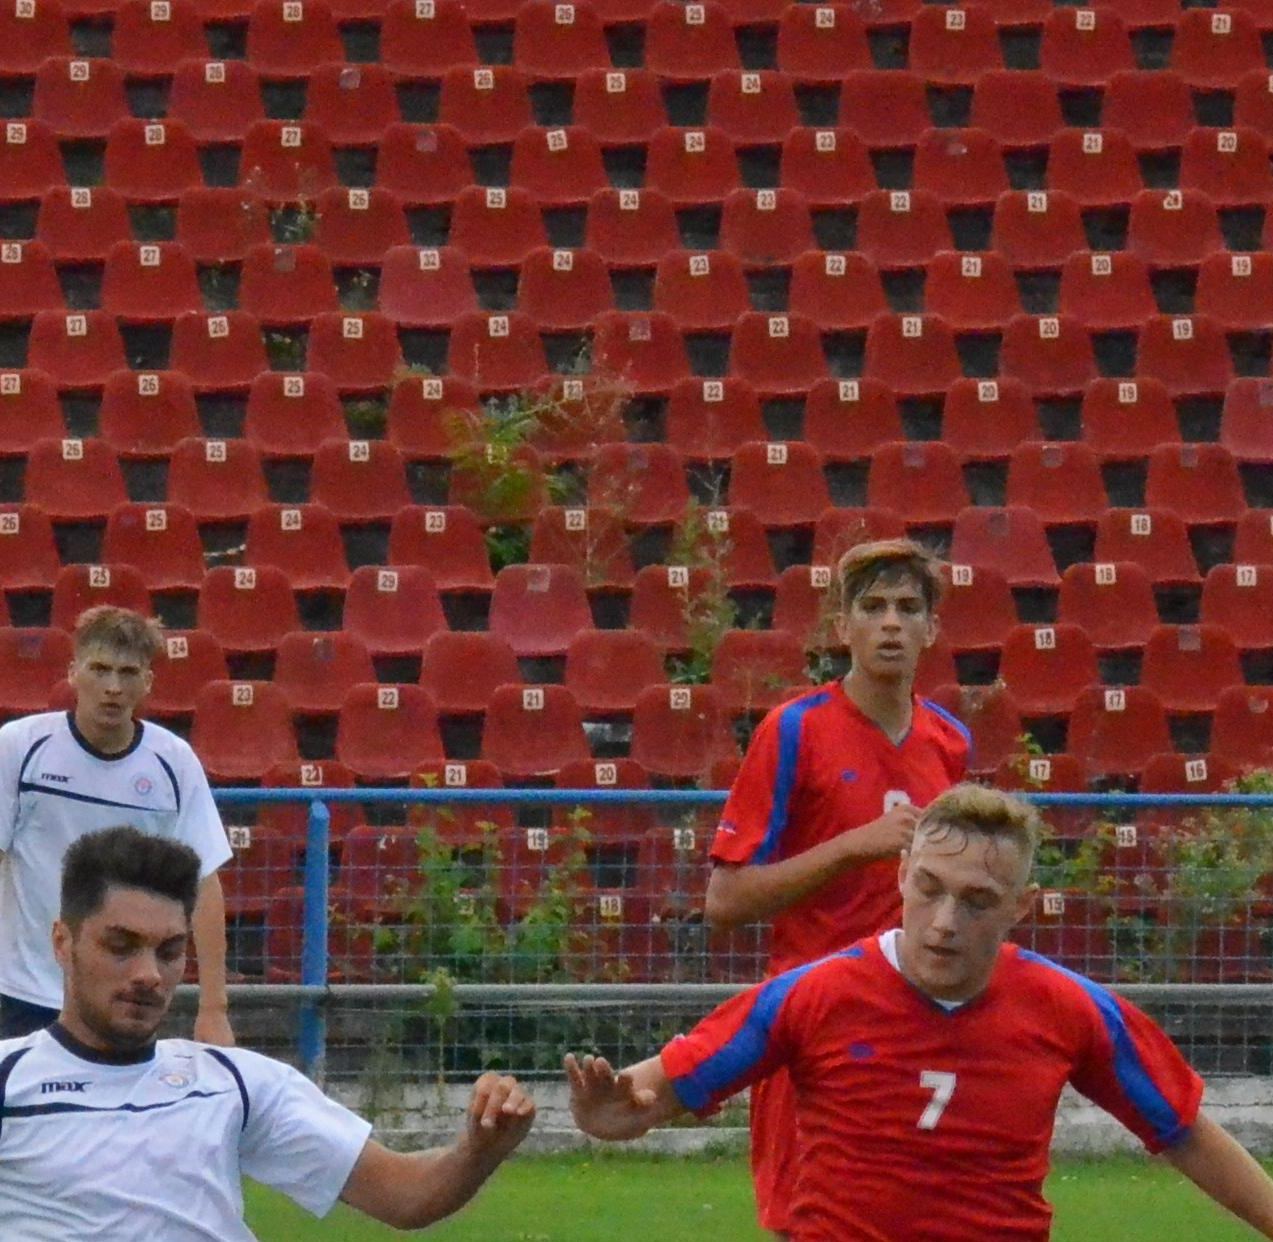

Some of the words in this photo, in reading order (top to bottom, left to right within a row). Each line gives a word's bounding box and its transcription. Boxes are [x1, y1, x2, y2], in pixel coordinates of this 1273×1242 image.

[74, 191, 89, 205] 28
[351, 193, 367, 207] 26
[488, 191, 504, 207] 25
[623, 194, 637, 207] 24
[894, 194, 907, 210] 22
[1030, 195, 1044, 210] 21
[693, 258, 708, 273] 23
[829, 259, 843, 274] 22
[964, 259, 978, 275] 21
[69, 318, 83, 333] 27
[211, 320, 227, 335] 26
[346, 321, 360, 336] 25
[493, 319, 507, 334] 24
[772, 320, 785, 335] 22
[1042, 321, 1057, 336] 20
[1176, 322, 1190, 337] 19
[3, 376, 17, 391] 27
[141, 377, 157, 393] 26
[426, 382, 441, 397] 24
[707, 384, 721, 399] 22
[842, 384, 856, 399] 21
[65, 442, 81, 457] 26
[352, 444, 368, 459] 24
[769, 446, 785, 462] 21
[2, 516, 17, 531] 26
[149, 513, 164, 528] 25
[238, 571, 254, 587] 24
[1039, 631, 1053, 646] 18
[381, 691, 395, 706] 22
[526, 692, 540, 708] 21
[599, 766, 615, 782] 20
[1033, 763, 1047, 778] 17
[1189, 763, 1205, 779] 16
[40, 1081, 94, 1094] max
[916, 1070, 957, 1130] 7
